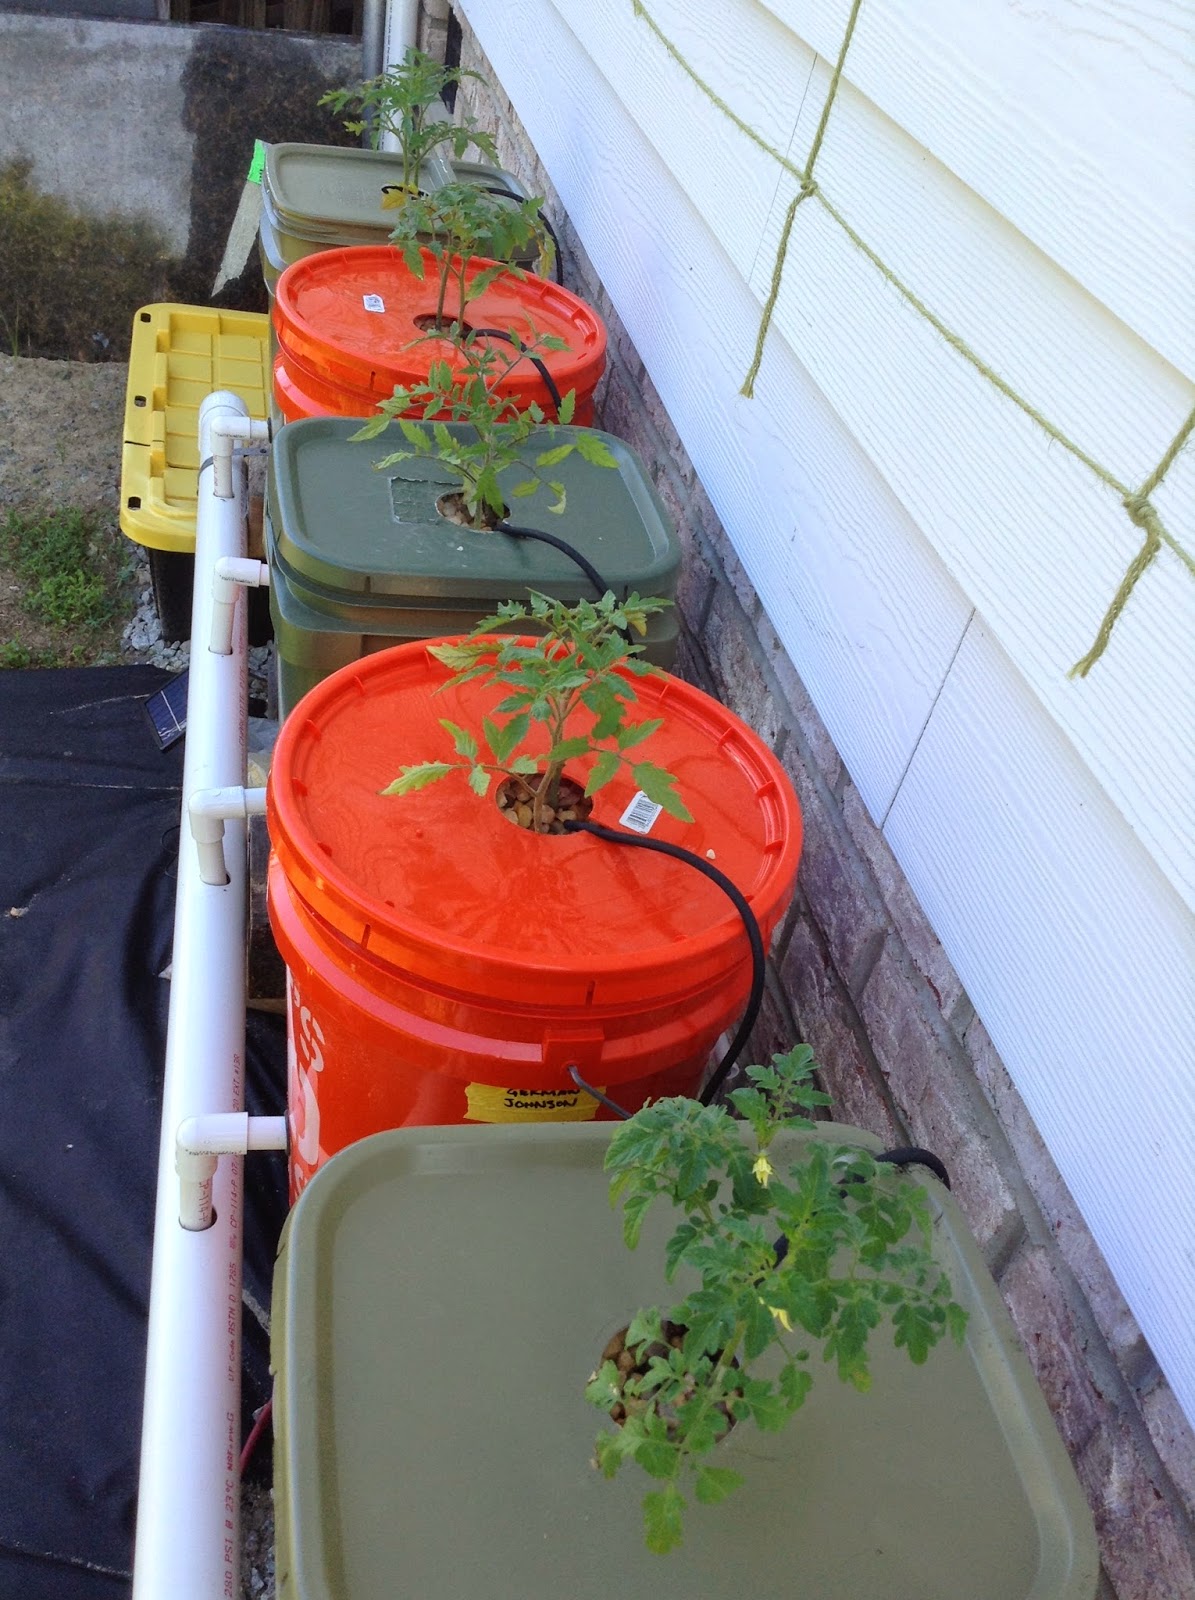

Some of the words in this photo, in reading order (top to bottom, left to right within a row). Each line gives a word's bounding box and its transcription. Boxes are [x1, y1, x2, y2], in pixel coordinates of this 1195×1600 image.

[504, 1098, 578, 1109] JOHNSON
[224, 1538, 233, 1564] PSI
[224, 1570, 233, 1598] 280
